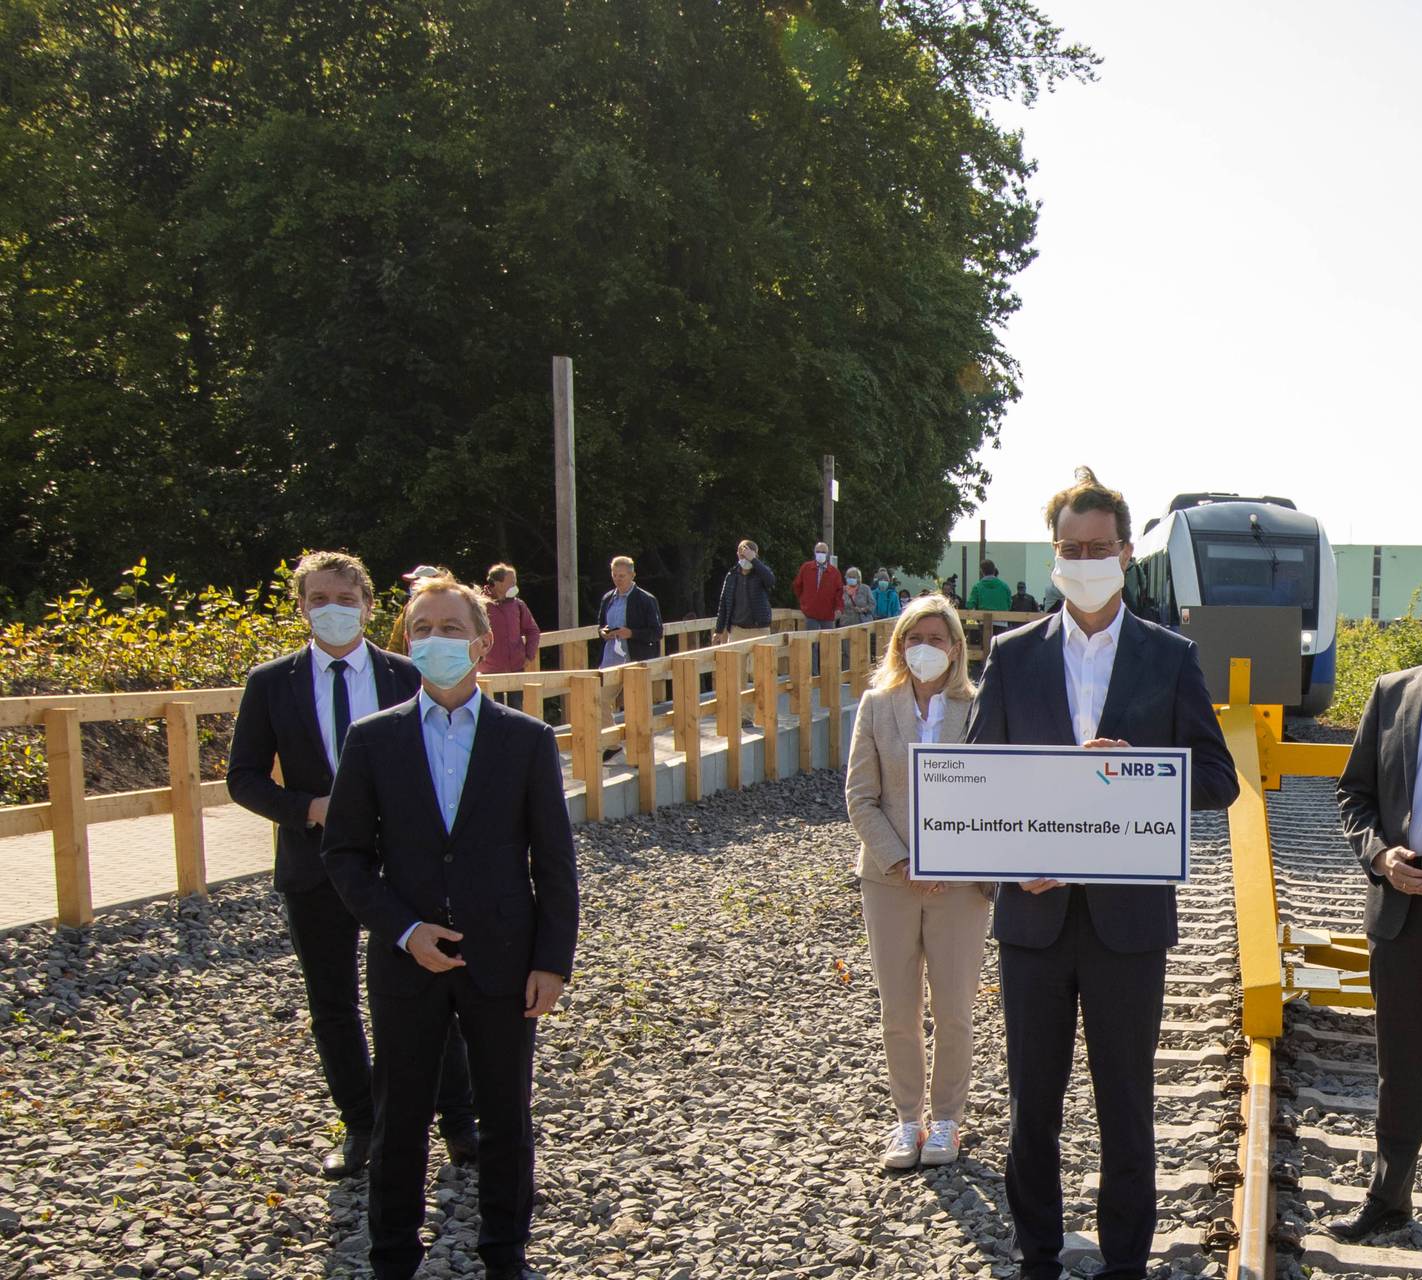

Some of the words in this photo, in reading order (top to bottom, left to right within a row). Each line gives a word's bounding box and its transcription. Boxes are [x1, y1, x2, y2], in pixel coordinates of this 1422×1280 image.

[923, 759, 965, 770] Herzlich
[1121, 762, 1155, 777] NRB
[923, 772, 987, 783] Willkommen
[923, 817, 1024, 834] Kamp-Lintfort
[1027, 819, 1120, 834] Kattenstraße
[1124, 821, 1130, 835] /
[1134, 821, 1176, 835] LAGA
